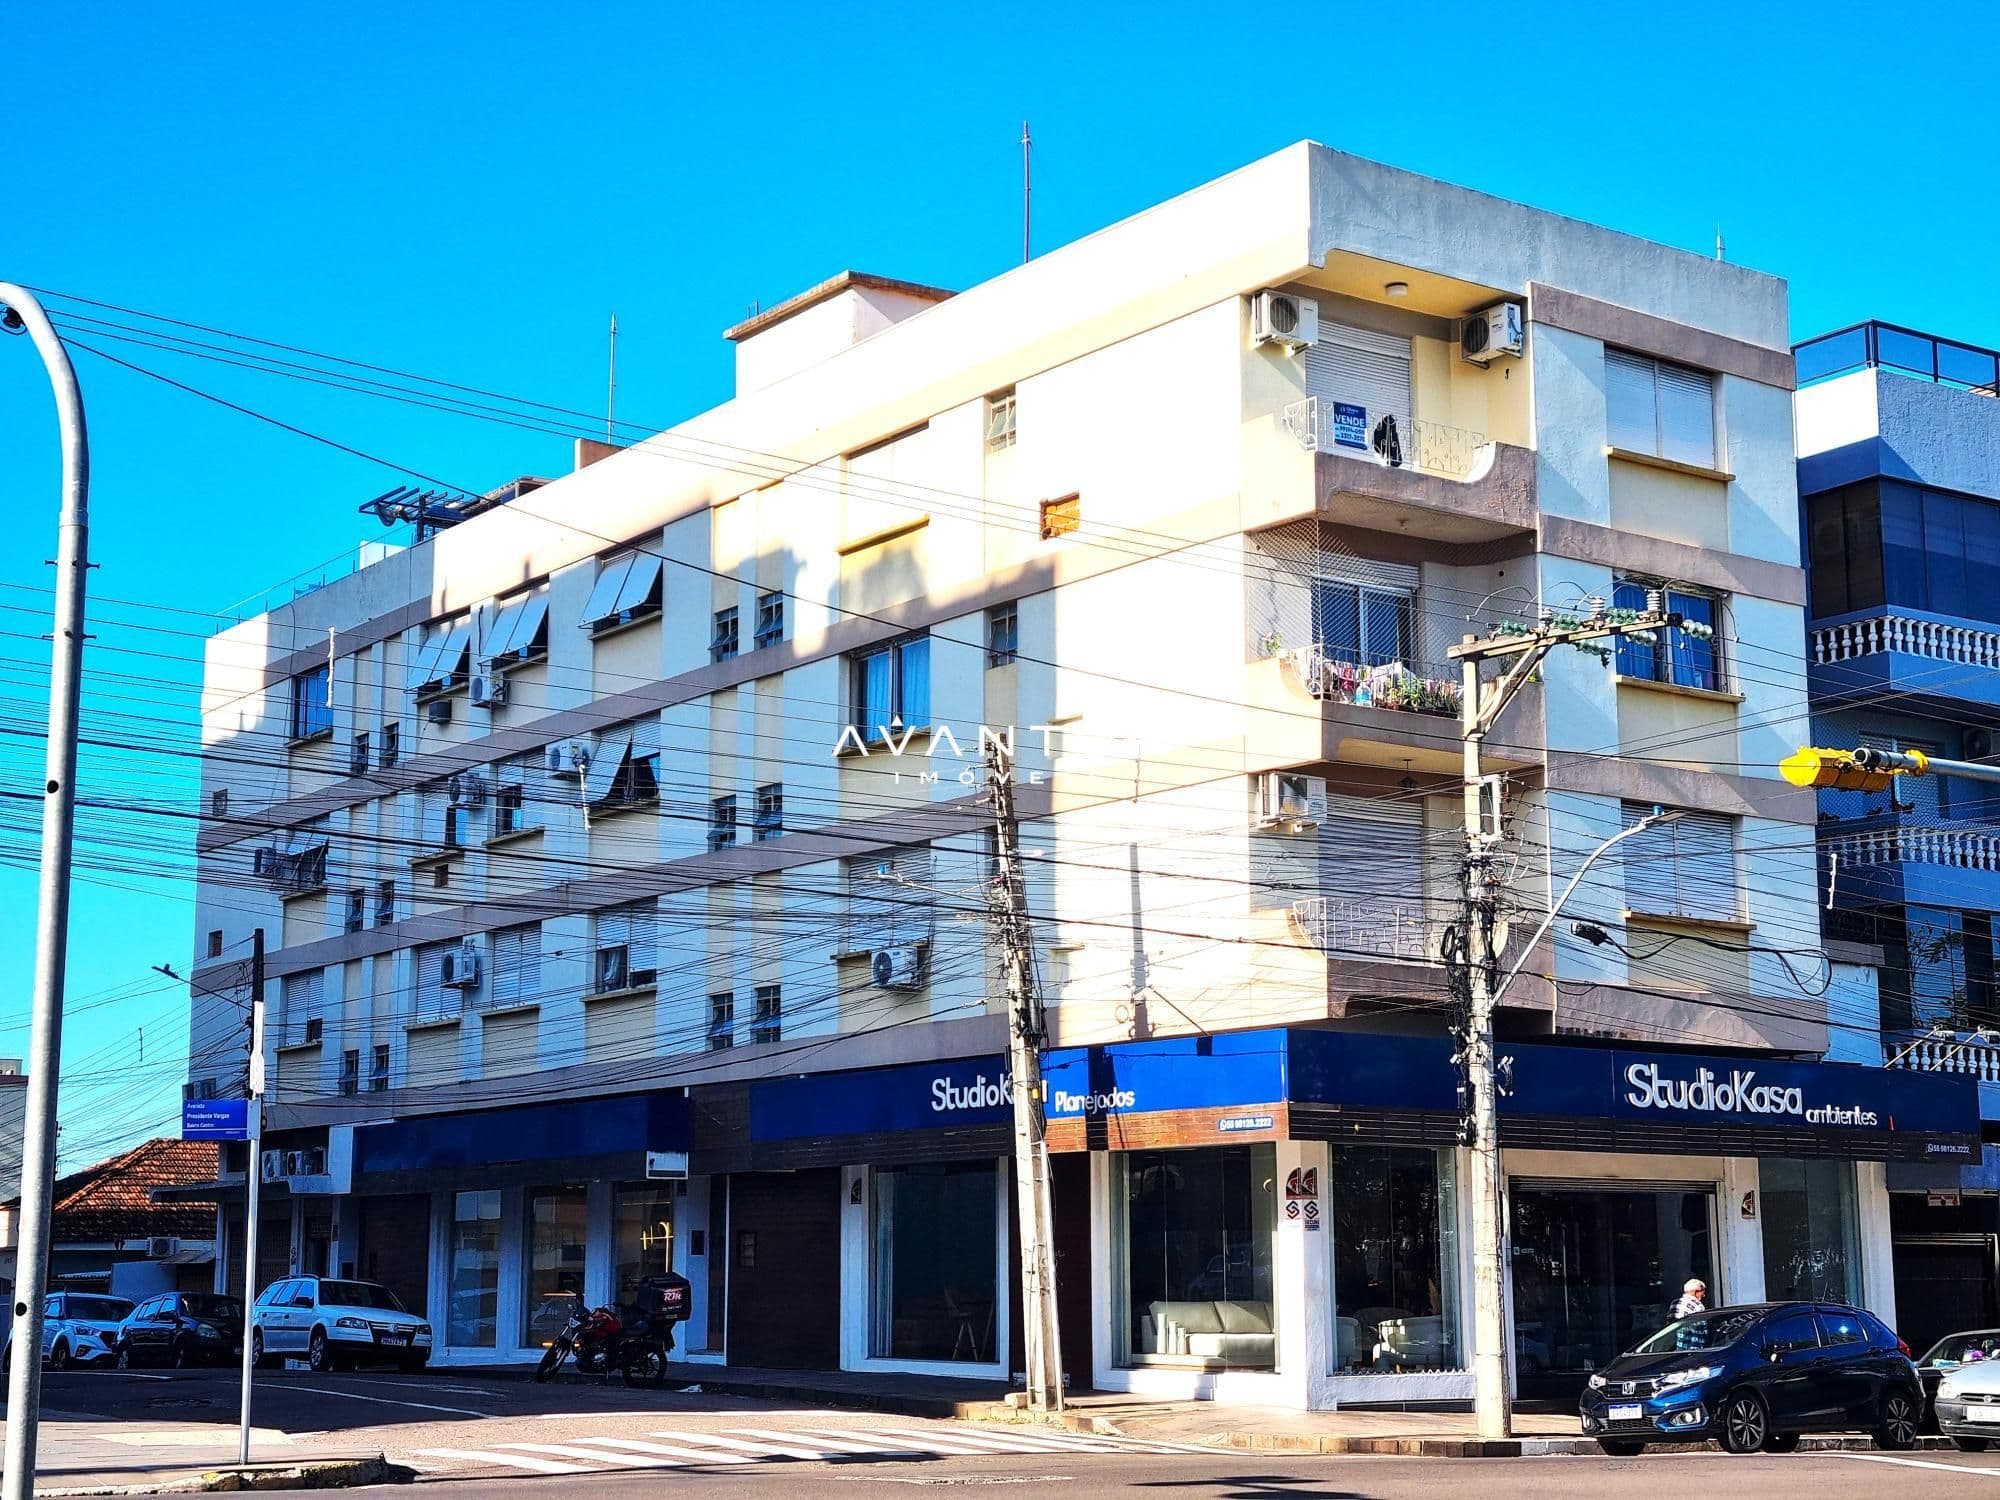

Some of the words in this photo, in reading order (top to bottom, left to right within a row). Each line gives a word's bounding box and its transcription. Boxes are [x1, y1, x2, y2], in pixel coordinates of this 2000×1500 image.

[1335, 413, 1365, 427] VENDE
[1055, 1087, 1135, 1115] Planejados
[1626, 1063, 1803, 1114] StudioKasa
[1805, 1104, 1877, 1126] ambientes
